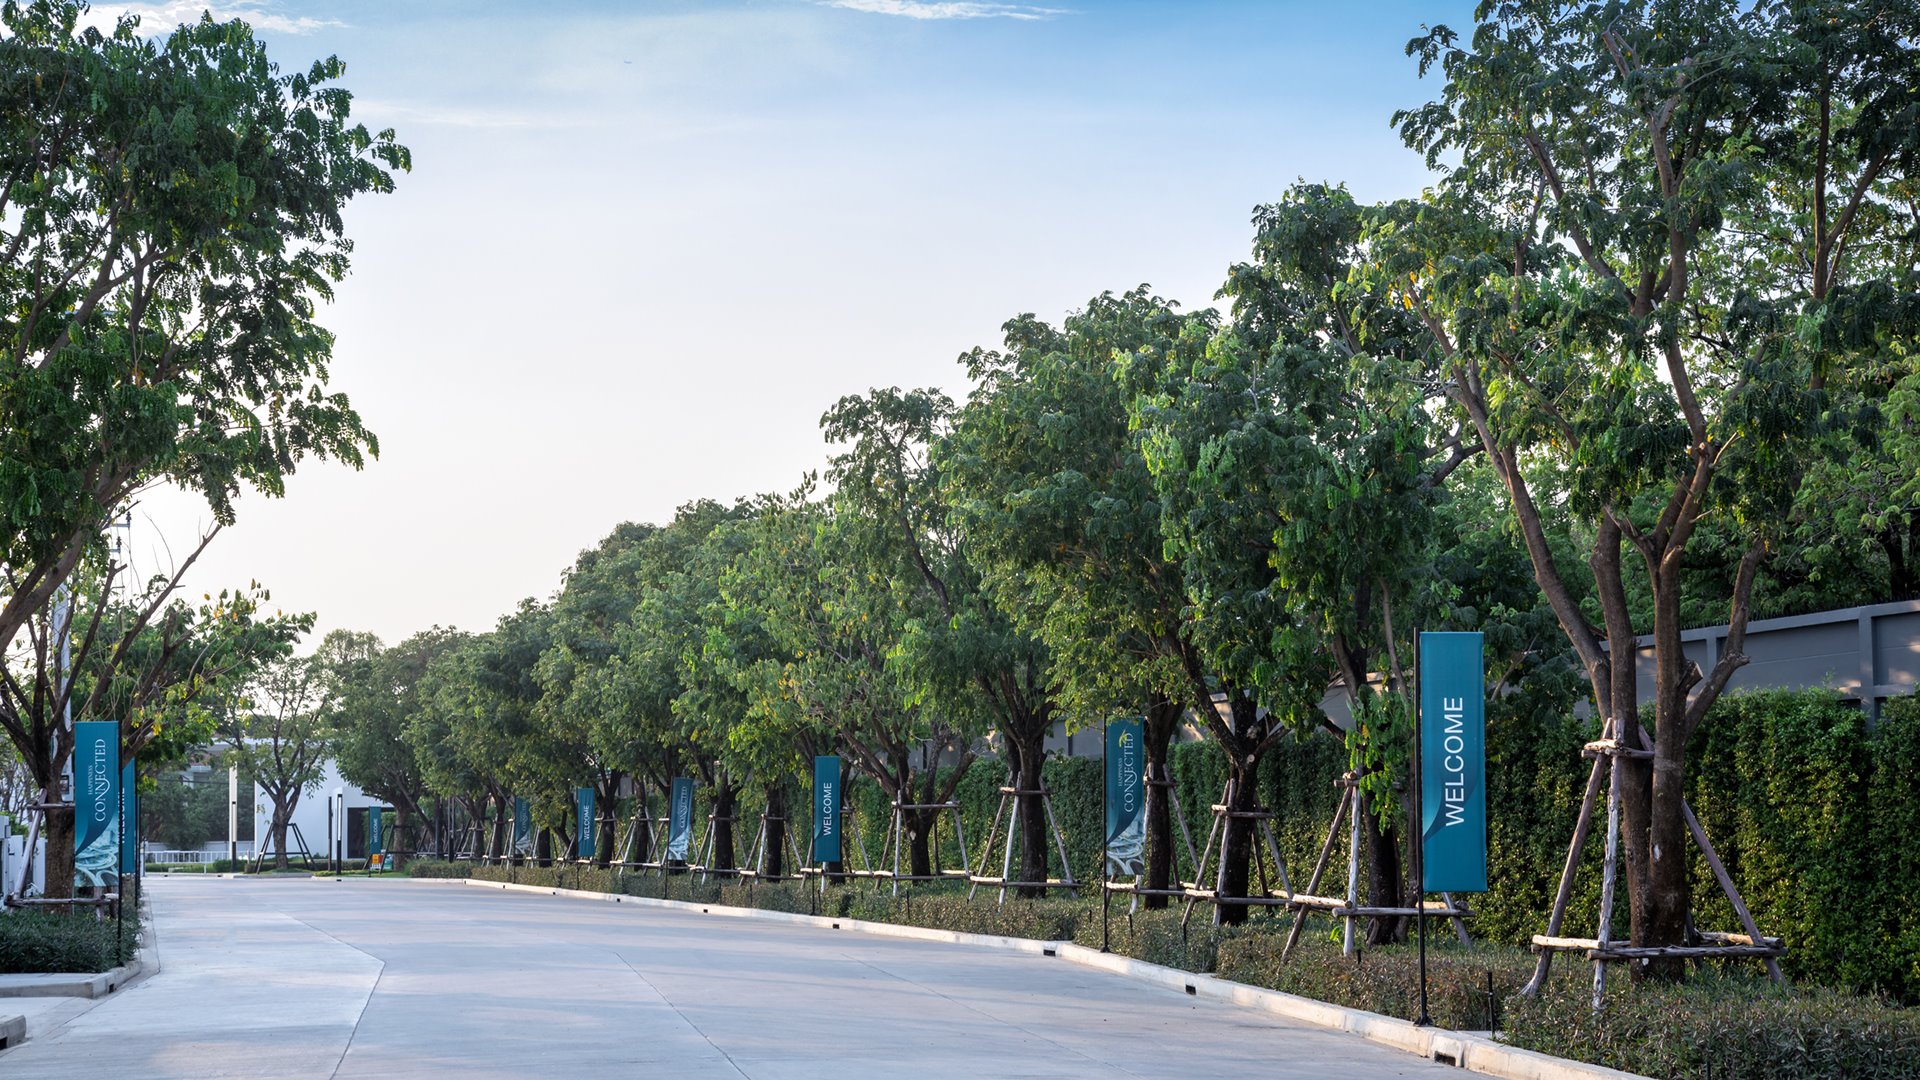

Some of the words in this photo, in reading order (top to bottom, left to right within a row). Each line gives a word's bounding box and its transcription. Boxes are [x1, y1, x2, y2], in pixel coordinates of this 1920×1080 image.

[95, 739, 110, 821] CONNECTED
[1123, 732, 1137, 812] CONNECTED
[1444, 697, 1465, 827] WELCOME
[583, 805, 591, 840] WELCOME
[823, 782, 832, 836] WELCOME
